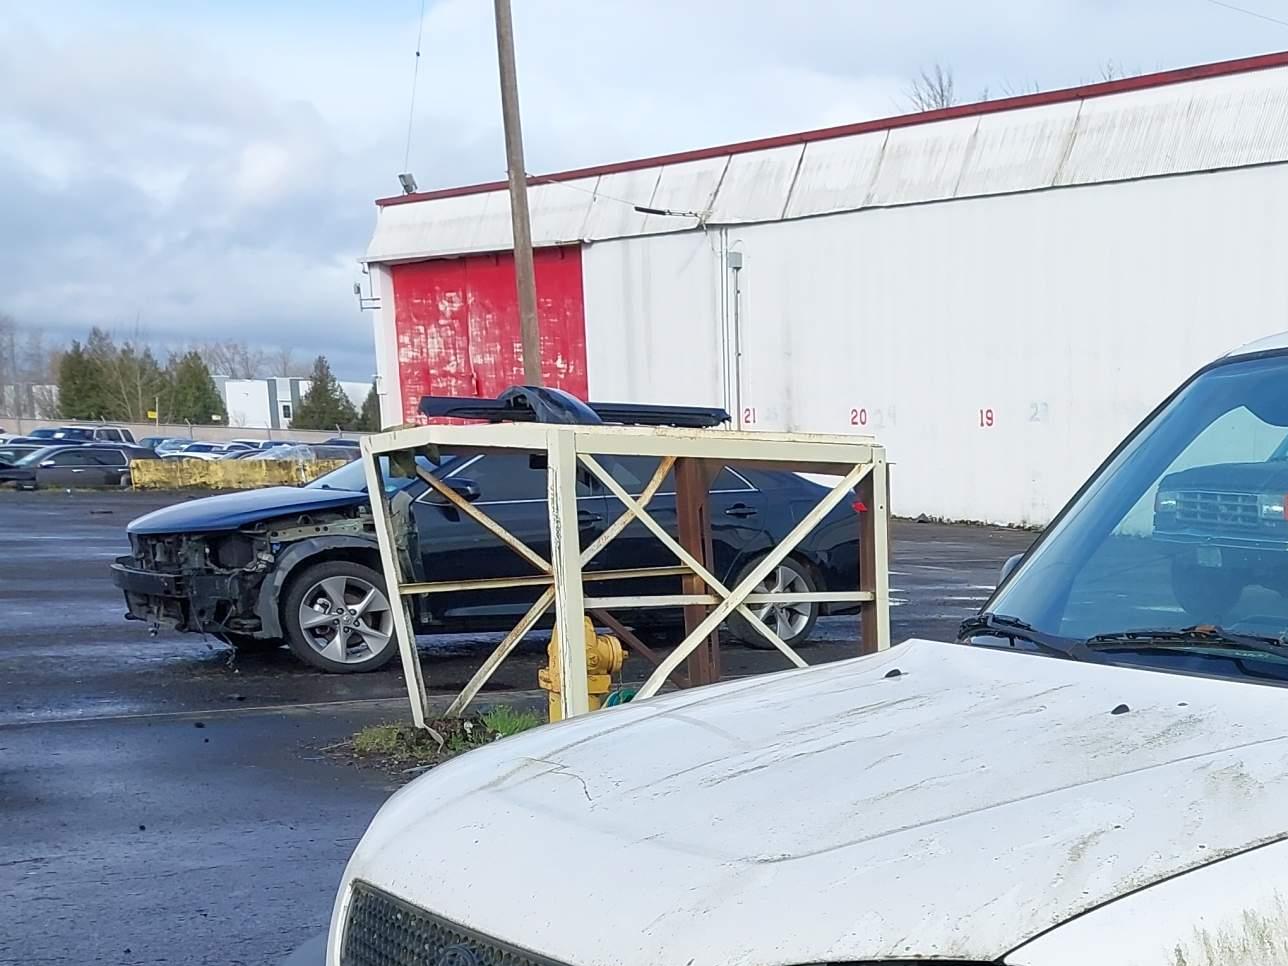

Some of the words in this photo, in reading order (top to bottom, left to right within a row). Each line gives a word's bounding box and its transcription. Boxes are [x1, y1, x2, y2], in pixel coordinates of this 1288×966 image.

[743, 407, 757, 424] 21
[850, 408, 868, 426] 20
[980, 409, 994, 427] 19
